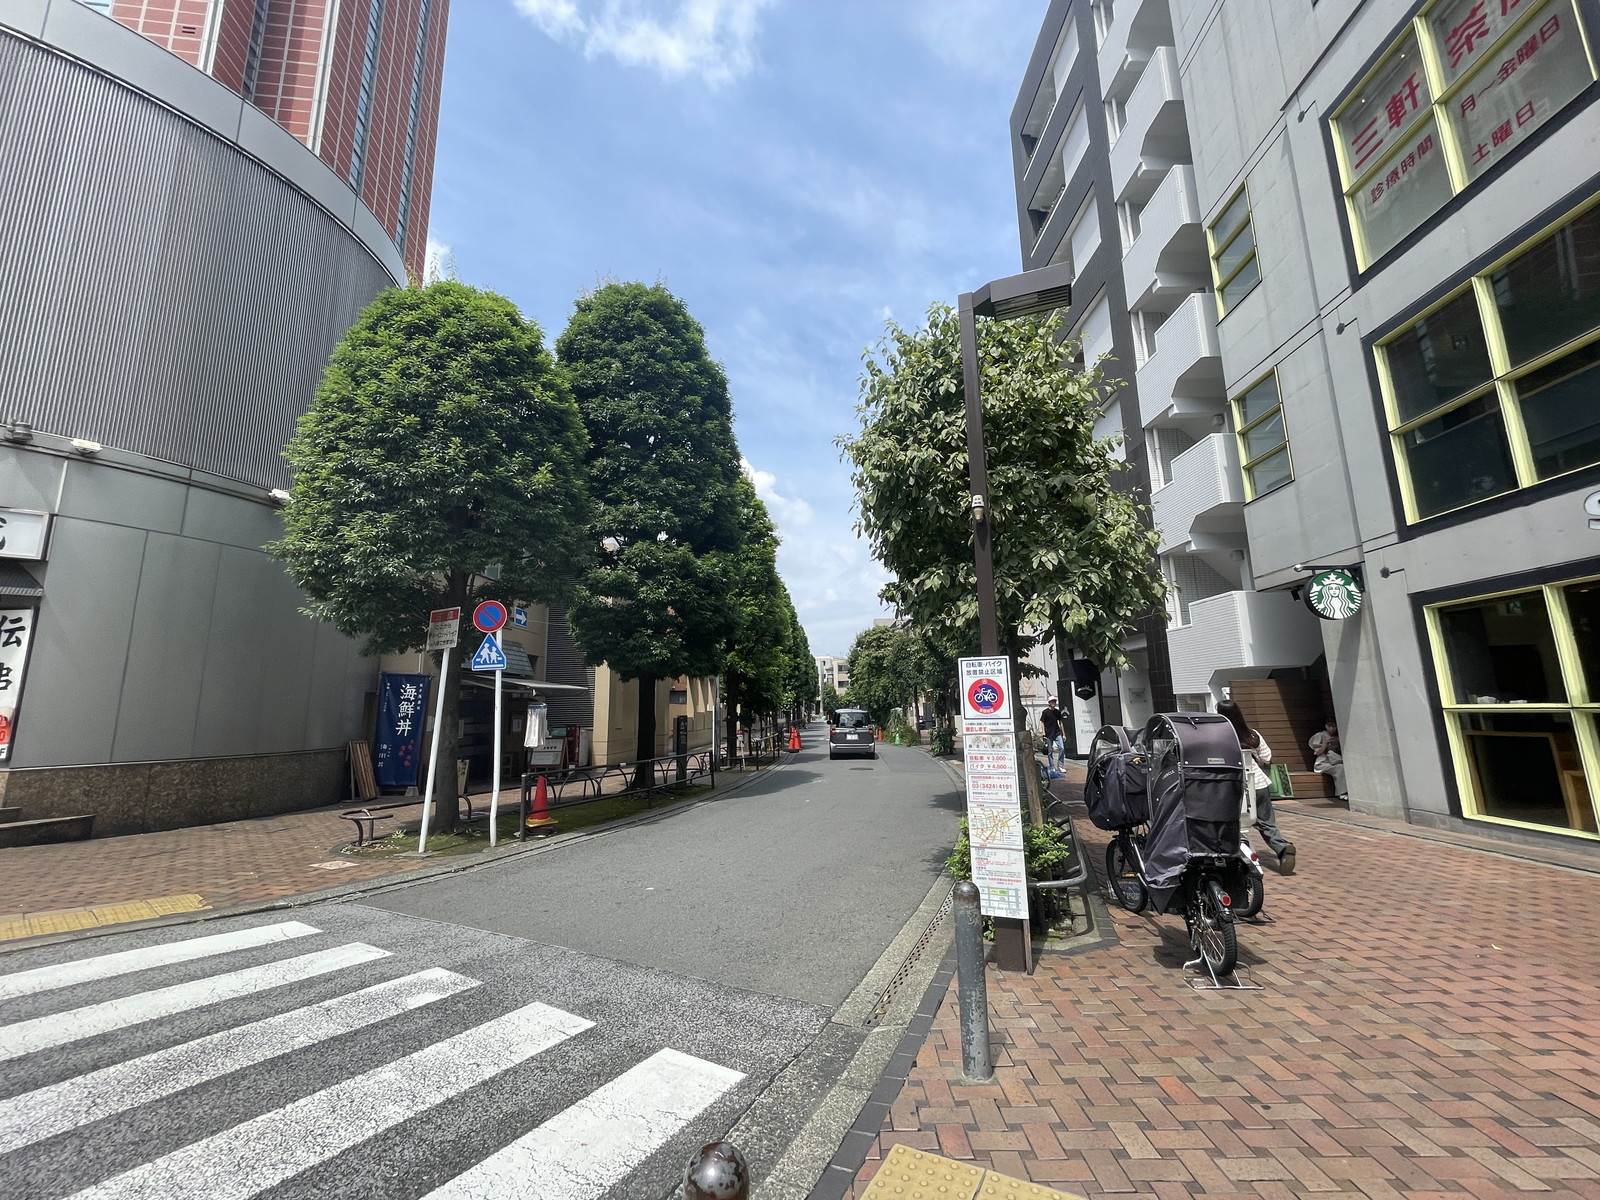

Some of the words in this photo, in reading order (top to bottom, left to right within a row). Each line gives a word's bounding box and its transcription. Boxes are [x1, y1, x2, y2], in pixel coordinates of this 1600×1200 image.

[1351, 72, 1421, 170] 三軒
[1472, 100, 1536, 166] 土曜日
[1370, 134, 1434, 204] 診療時間
[395, 683, 417, 737] 海鮮丼
